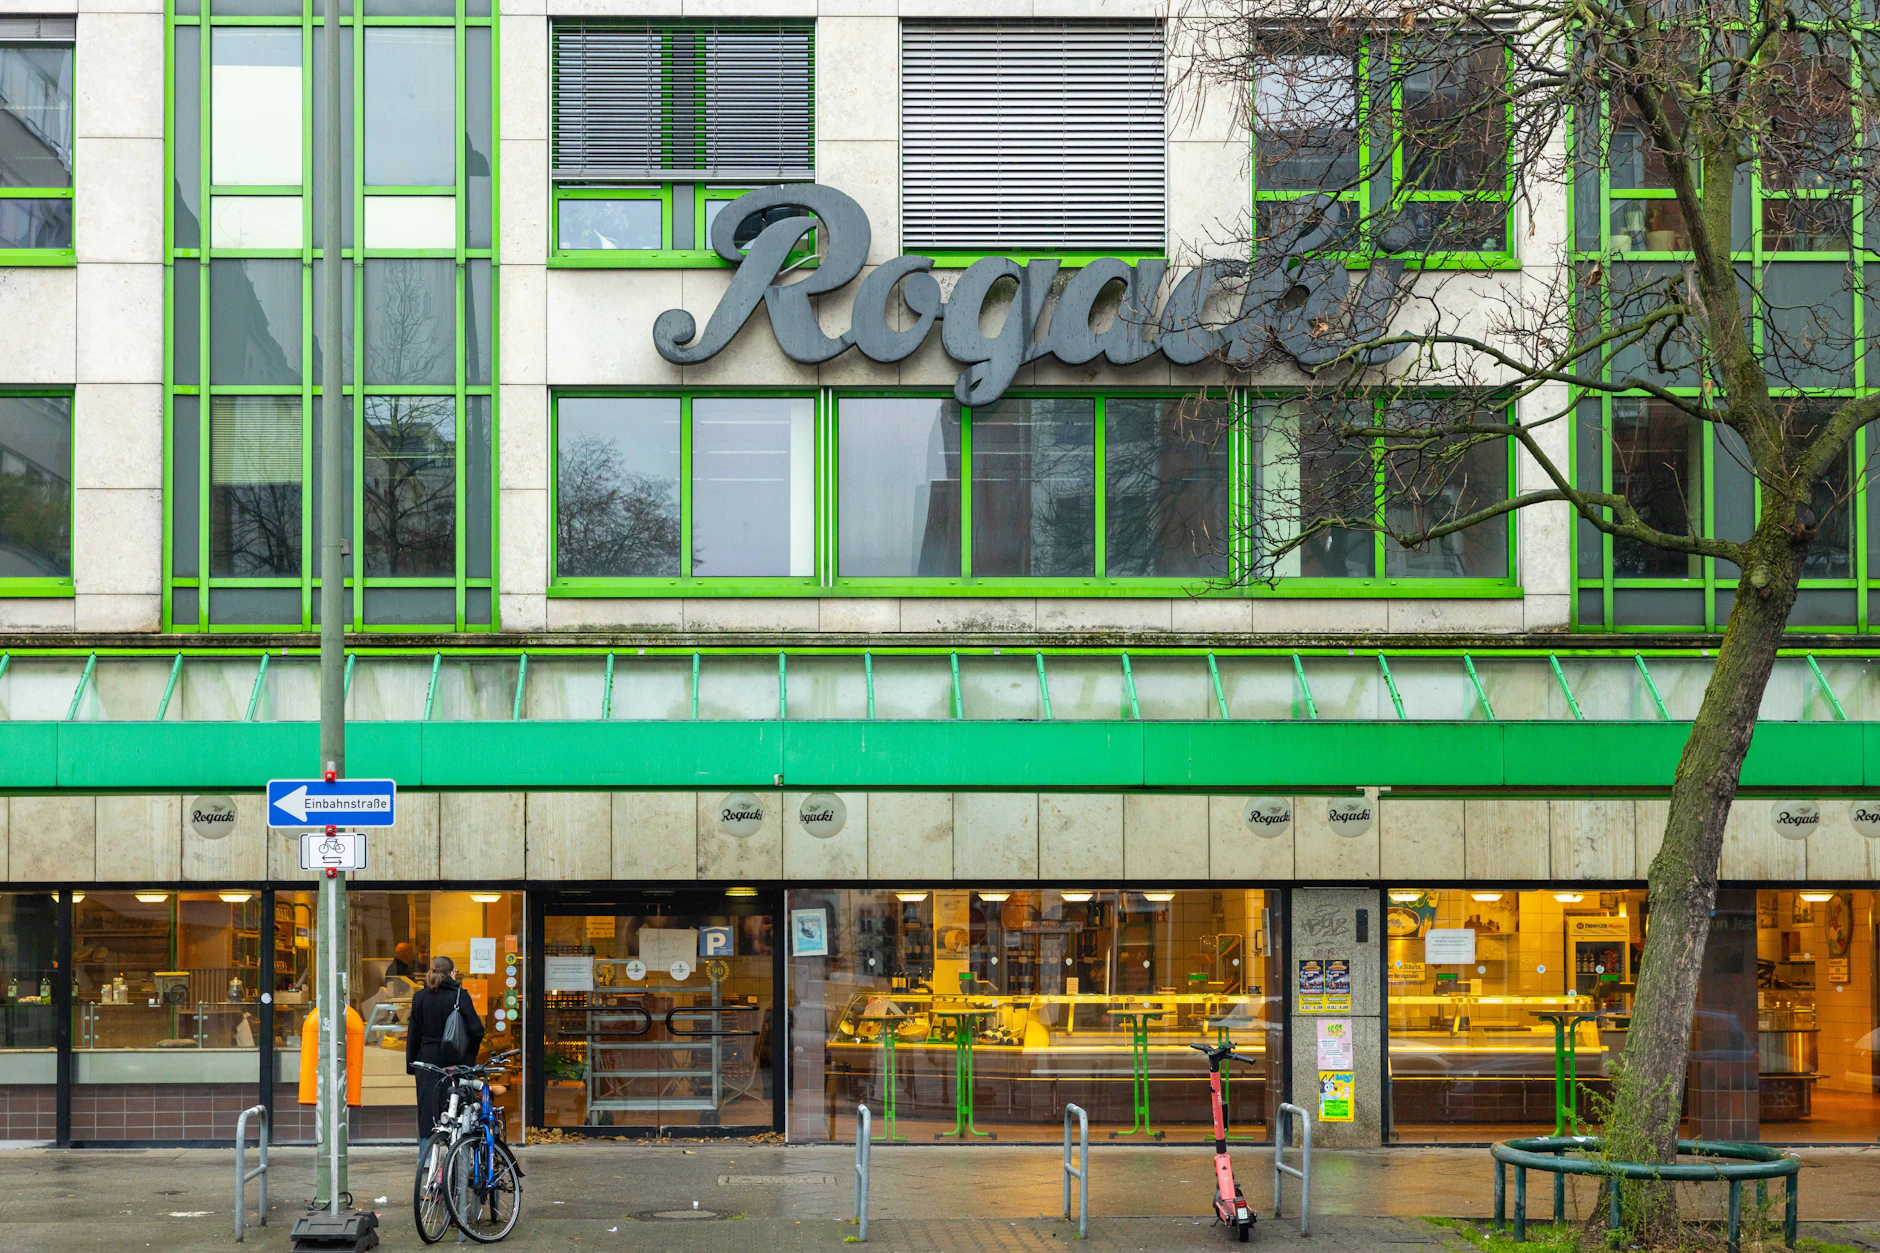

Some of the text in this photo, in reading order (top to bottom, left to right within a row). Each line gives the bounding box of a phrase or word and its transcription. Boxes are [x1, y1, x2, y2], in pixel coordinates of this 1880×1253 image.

[653, 183, 1411, 406] Rogacki
[304, 798, 388, 809] Einbahnstraße
[192, 810, 235, 824] Rogacki
[721, 808, 763, 822] Rogacki
[1328, 808, 1370, 823] Rogacki
[1777, 812, 1819, 826] Rogack
[1854, 808, 1880, 823] Rog
[707, 932, 726, 956] P
[711, 966, 724, 975] 90
